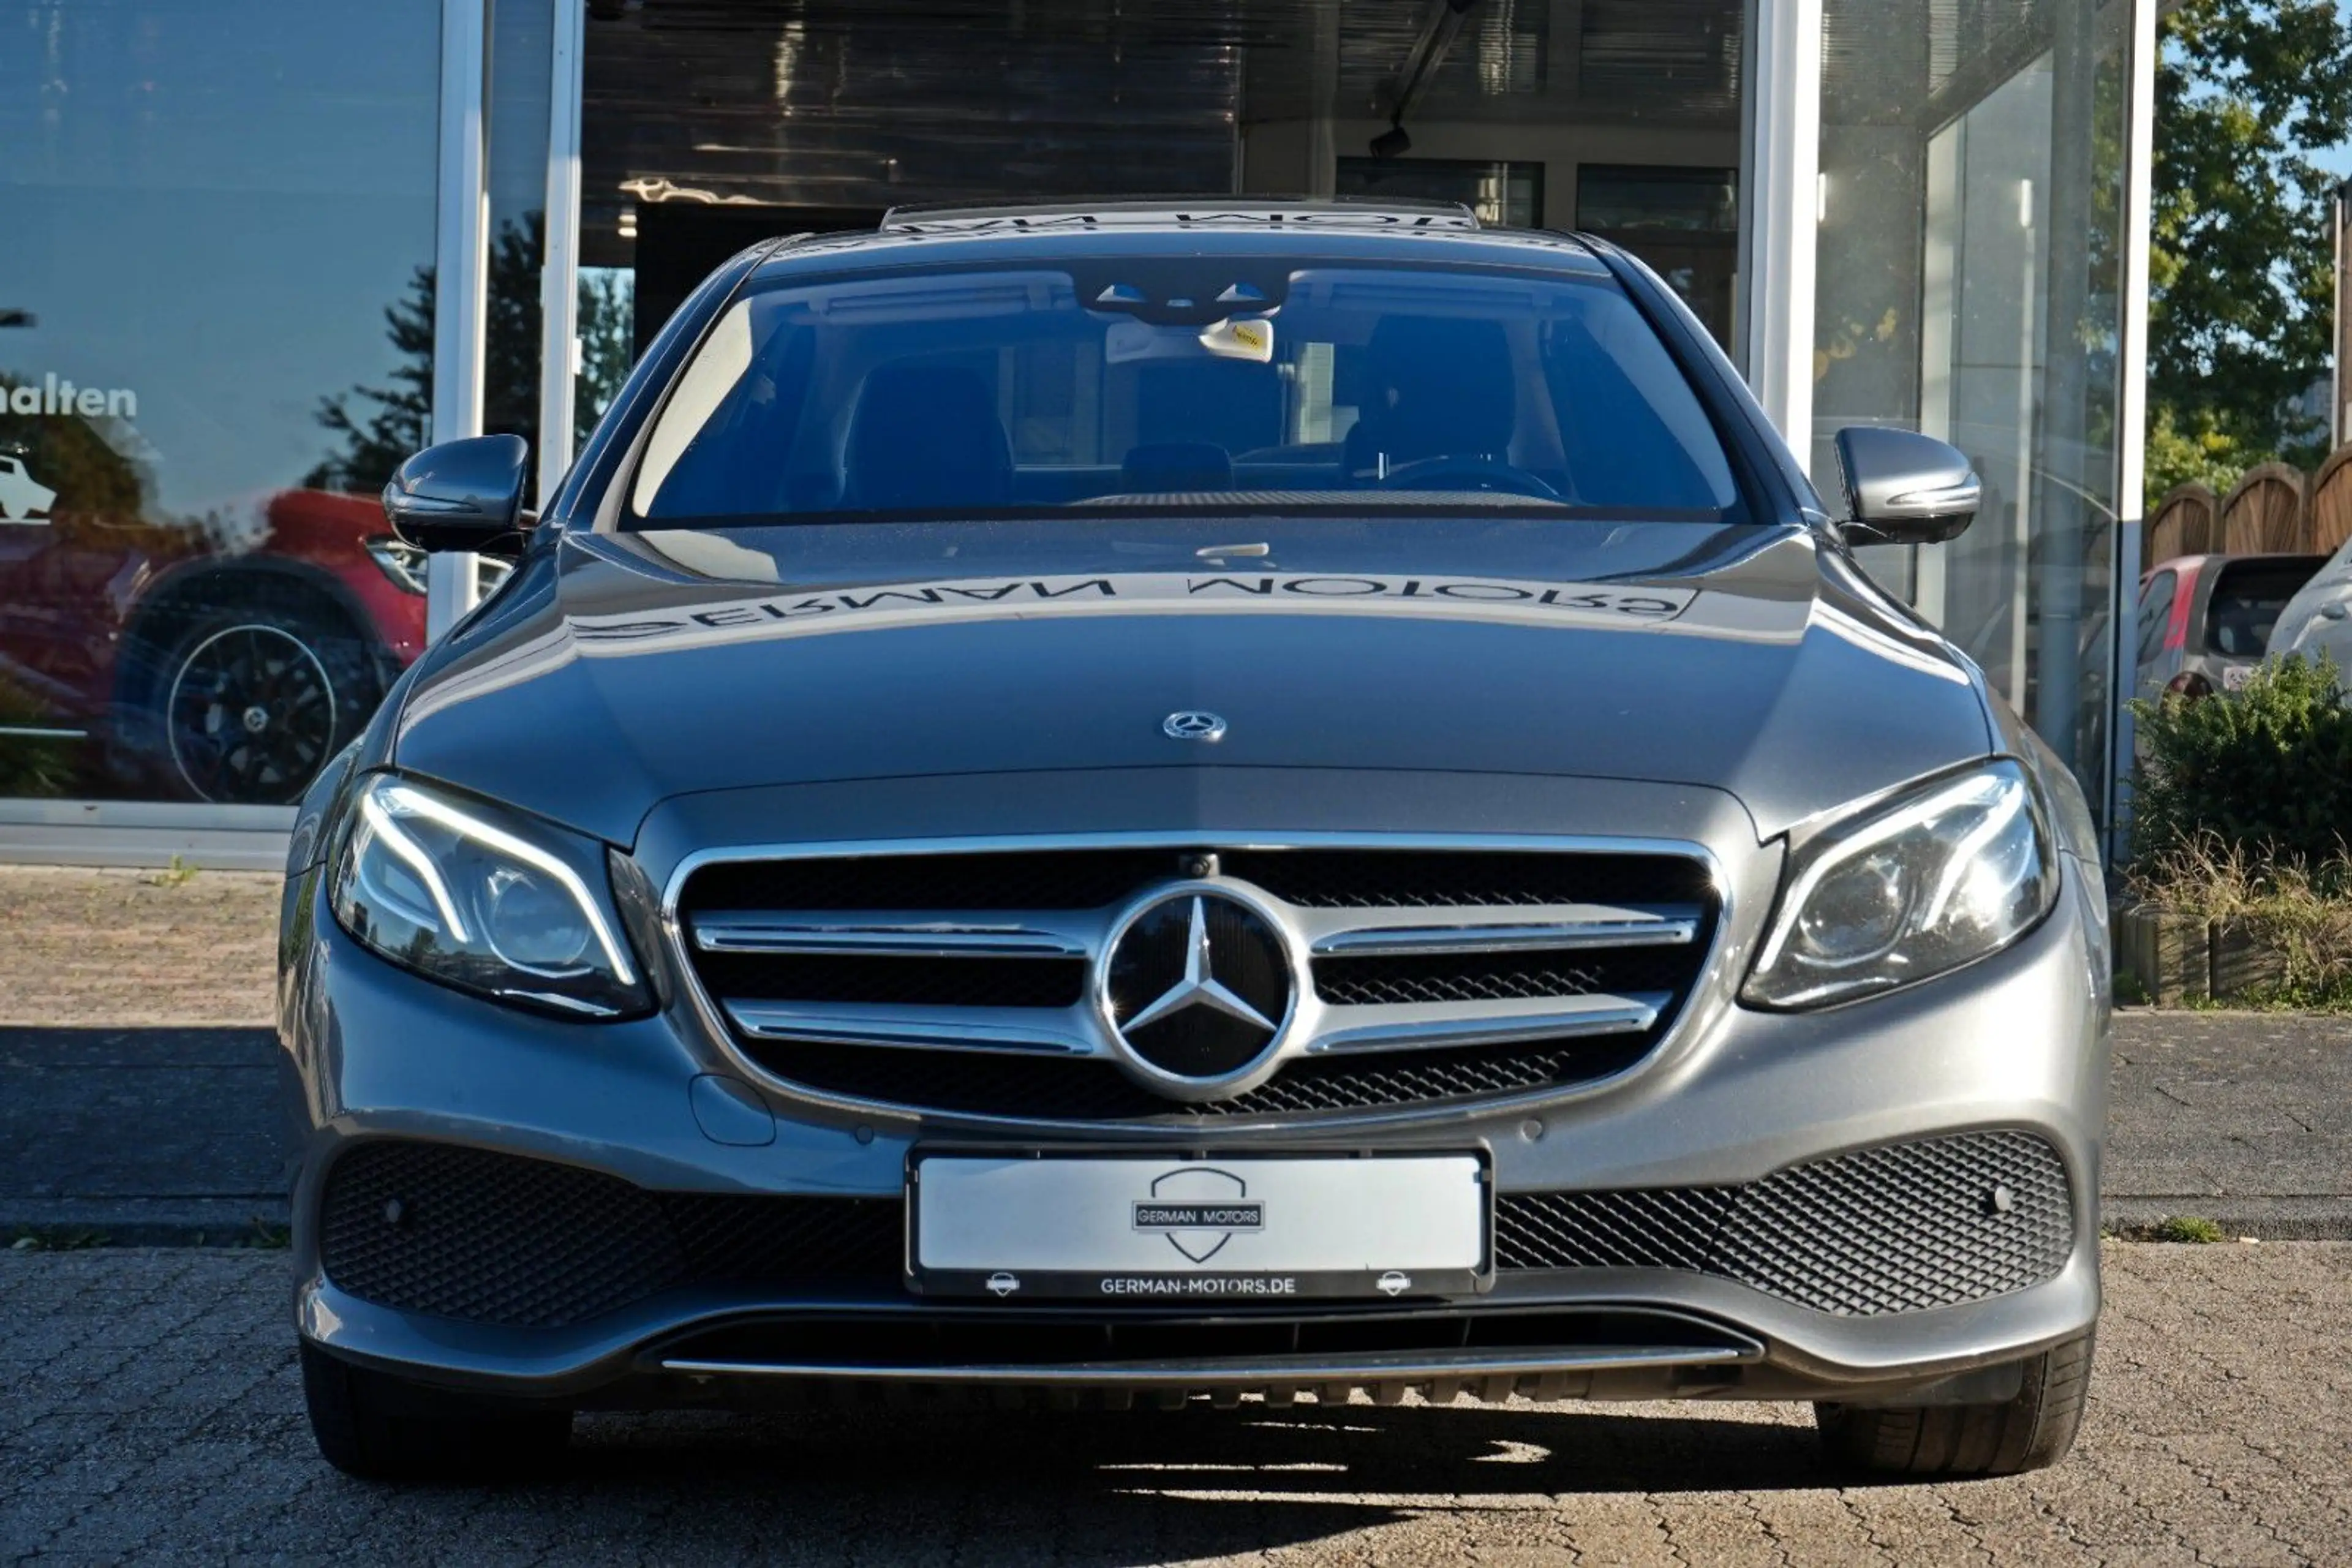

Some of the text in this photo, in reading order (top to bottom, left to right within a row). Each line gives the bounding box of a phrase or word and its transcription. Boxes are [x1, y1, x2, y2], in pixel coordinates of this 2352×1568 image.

[0, 372, 137, 417] alten
[1137, 1209, 1259, 1223] GERMAN MOTORS
[1101, 1278, 1296, 1295] GERMAN-MOTORS.DE
